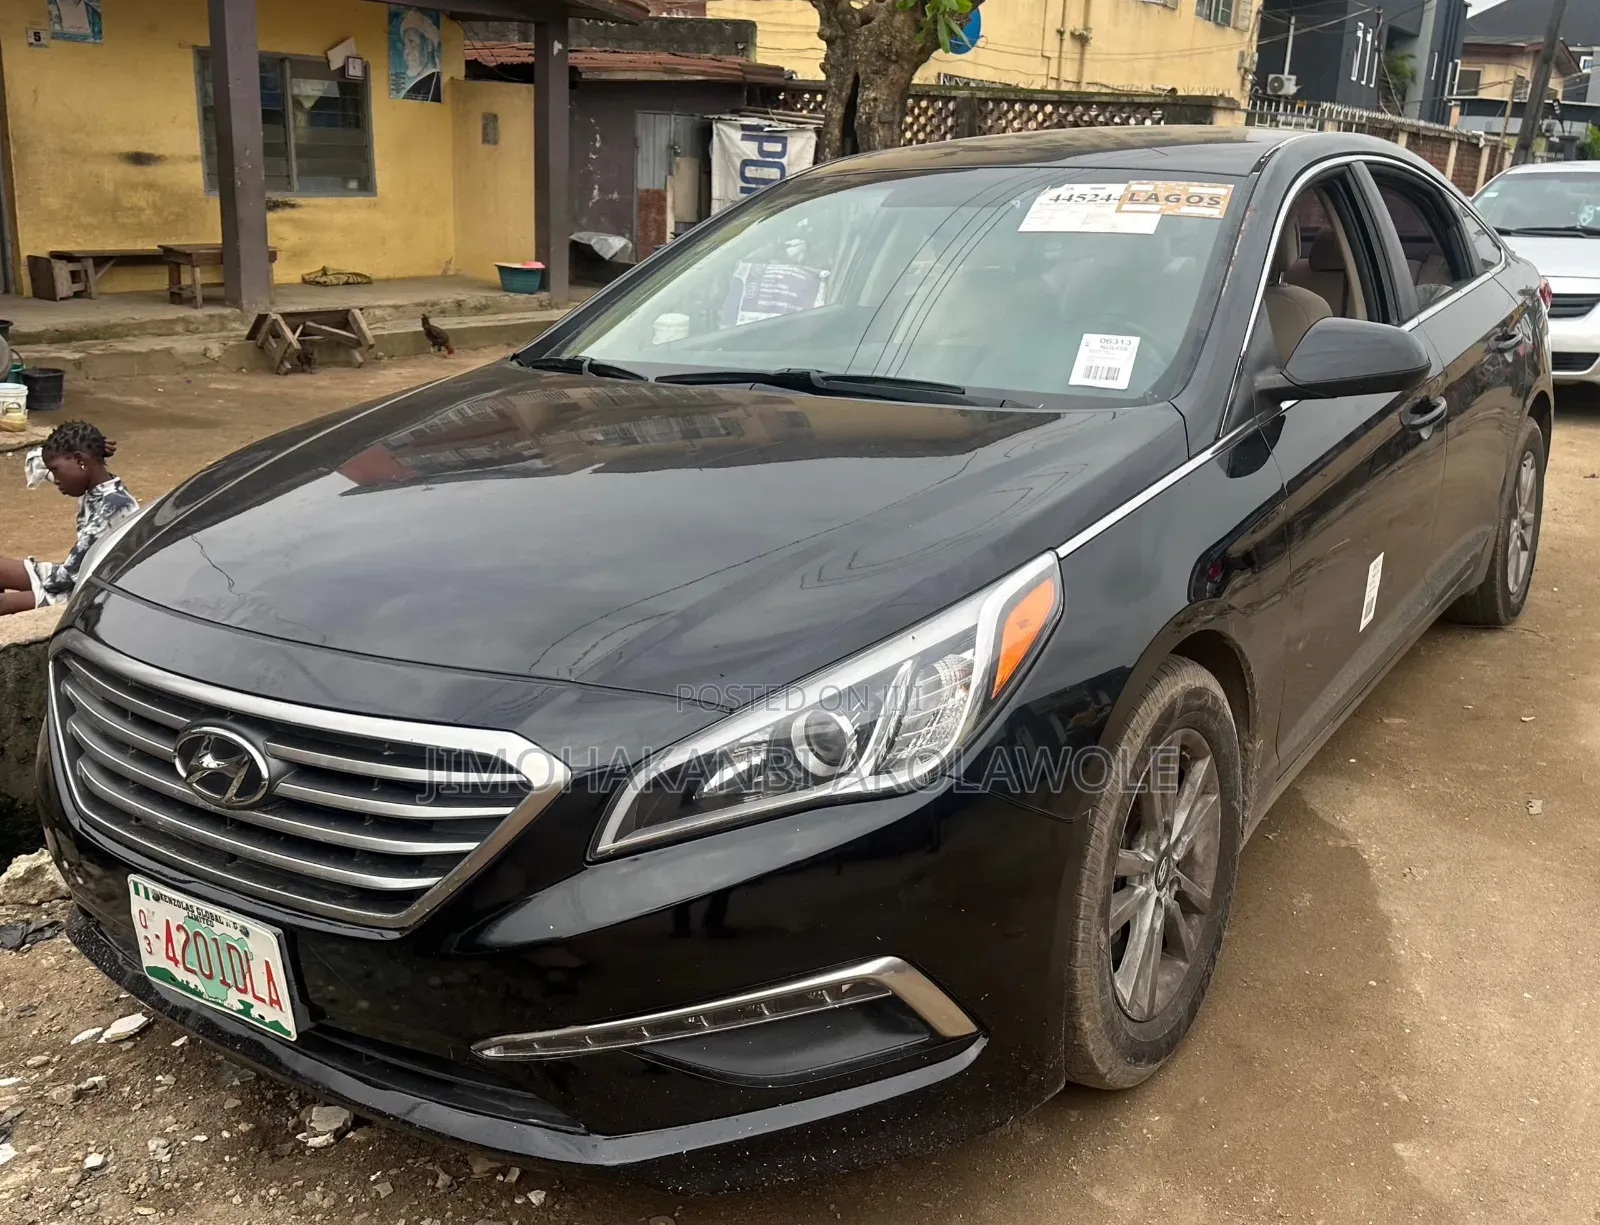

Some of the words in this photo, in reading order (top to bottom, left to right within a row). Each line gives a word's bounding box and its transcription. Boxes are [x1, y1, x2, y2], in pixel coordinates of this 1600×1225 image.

[33, 31, 41, 42] 5
[739, 124, 788, 194] PO
[1128, 192, 1222, 206] LAGOS
[1099, 338, 1132, 346] 06313
[187, 912, 214, 928] LIMITED
[195, 907, 224, 925] GLOBAL
